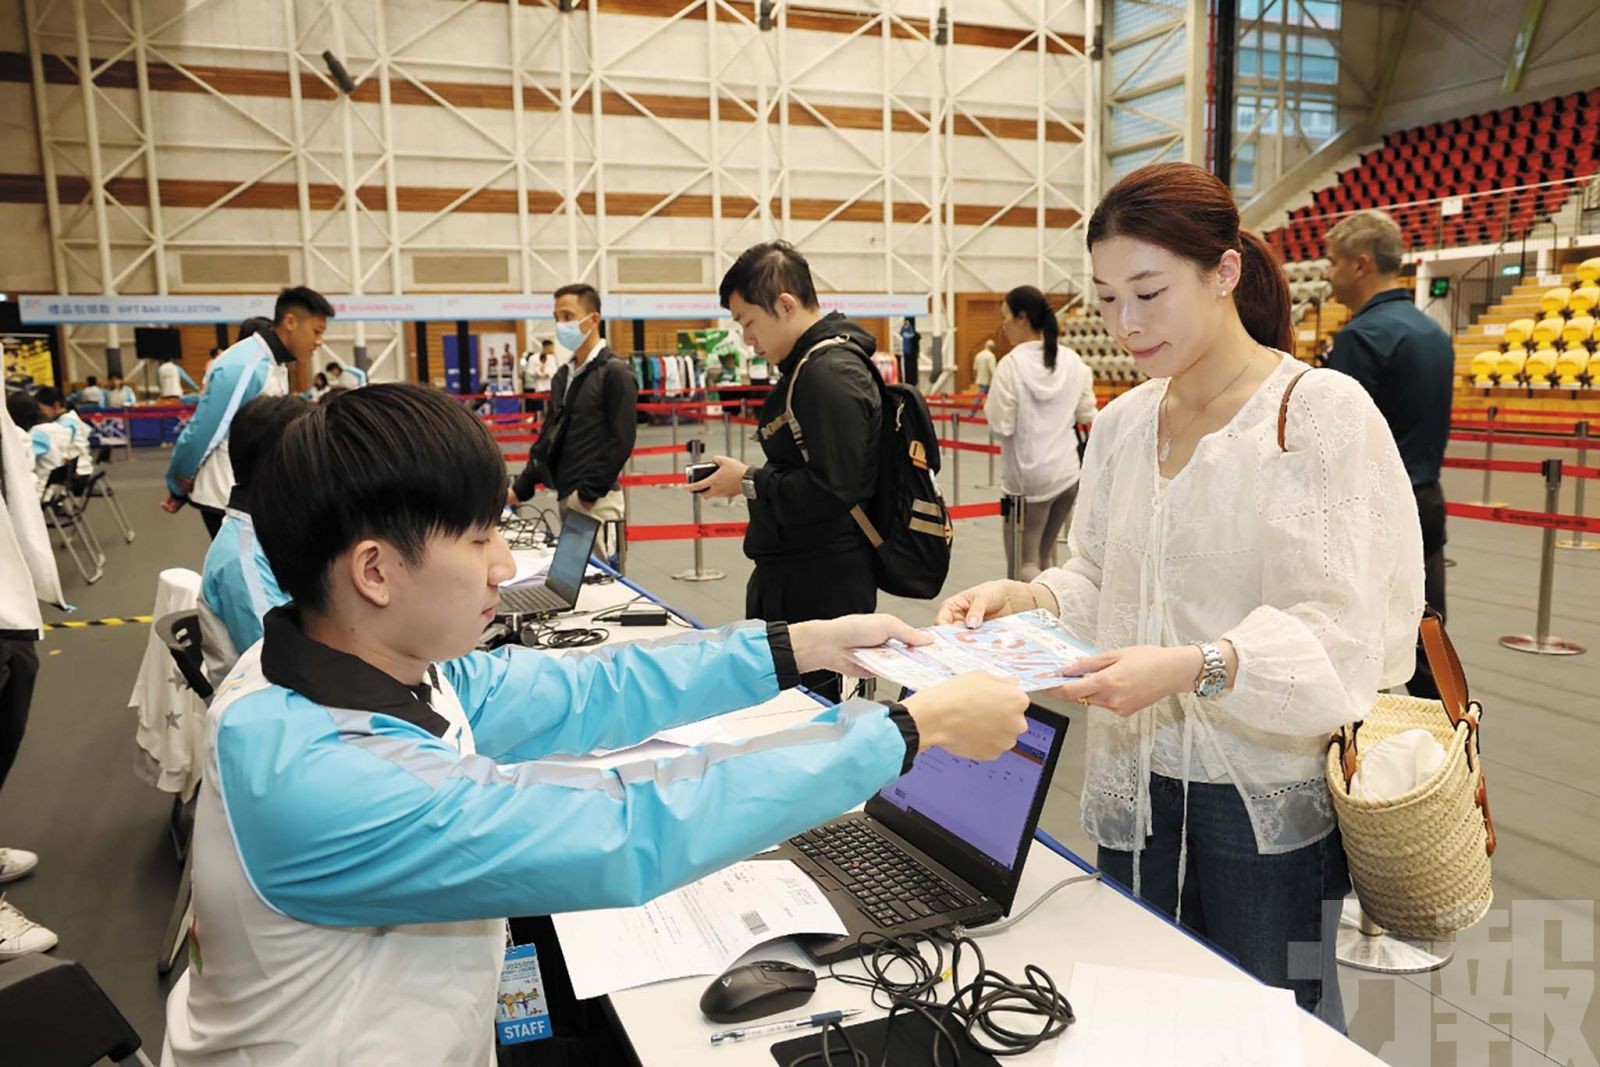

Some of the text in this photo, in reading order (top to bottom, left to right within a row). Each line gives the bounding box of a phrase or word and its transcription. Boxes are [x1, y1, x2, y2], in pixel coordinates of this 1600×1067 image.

[117, 305, 140, 313] GIFT
[142, 305, 161, 313] BAG
[163, 305, 222, 313] COLLECTION
[504, 1020, 545, 1041] STAFF
